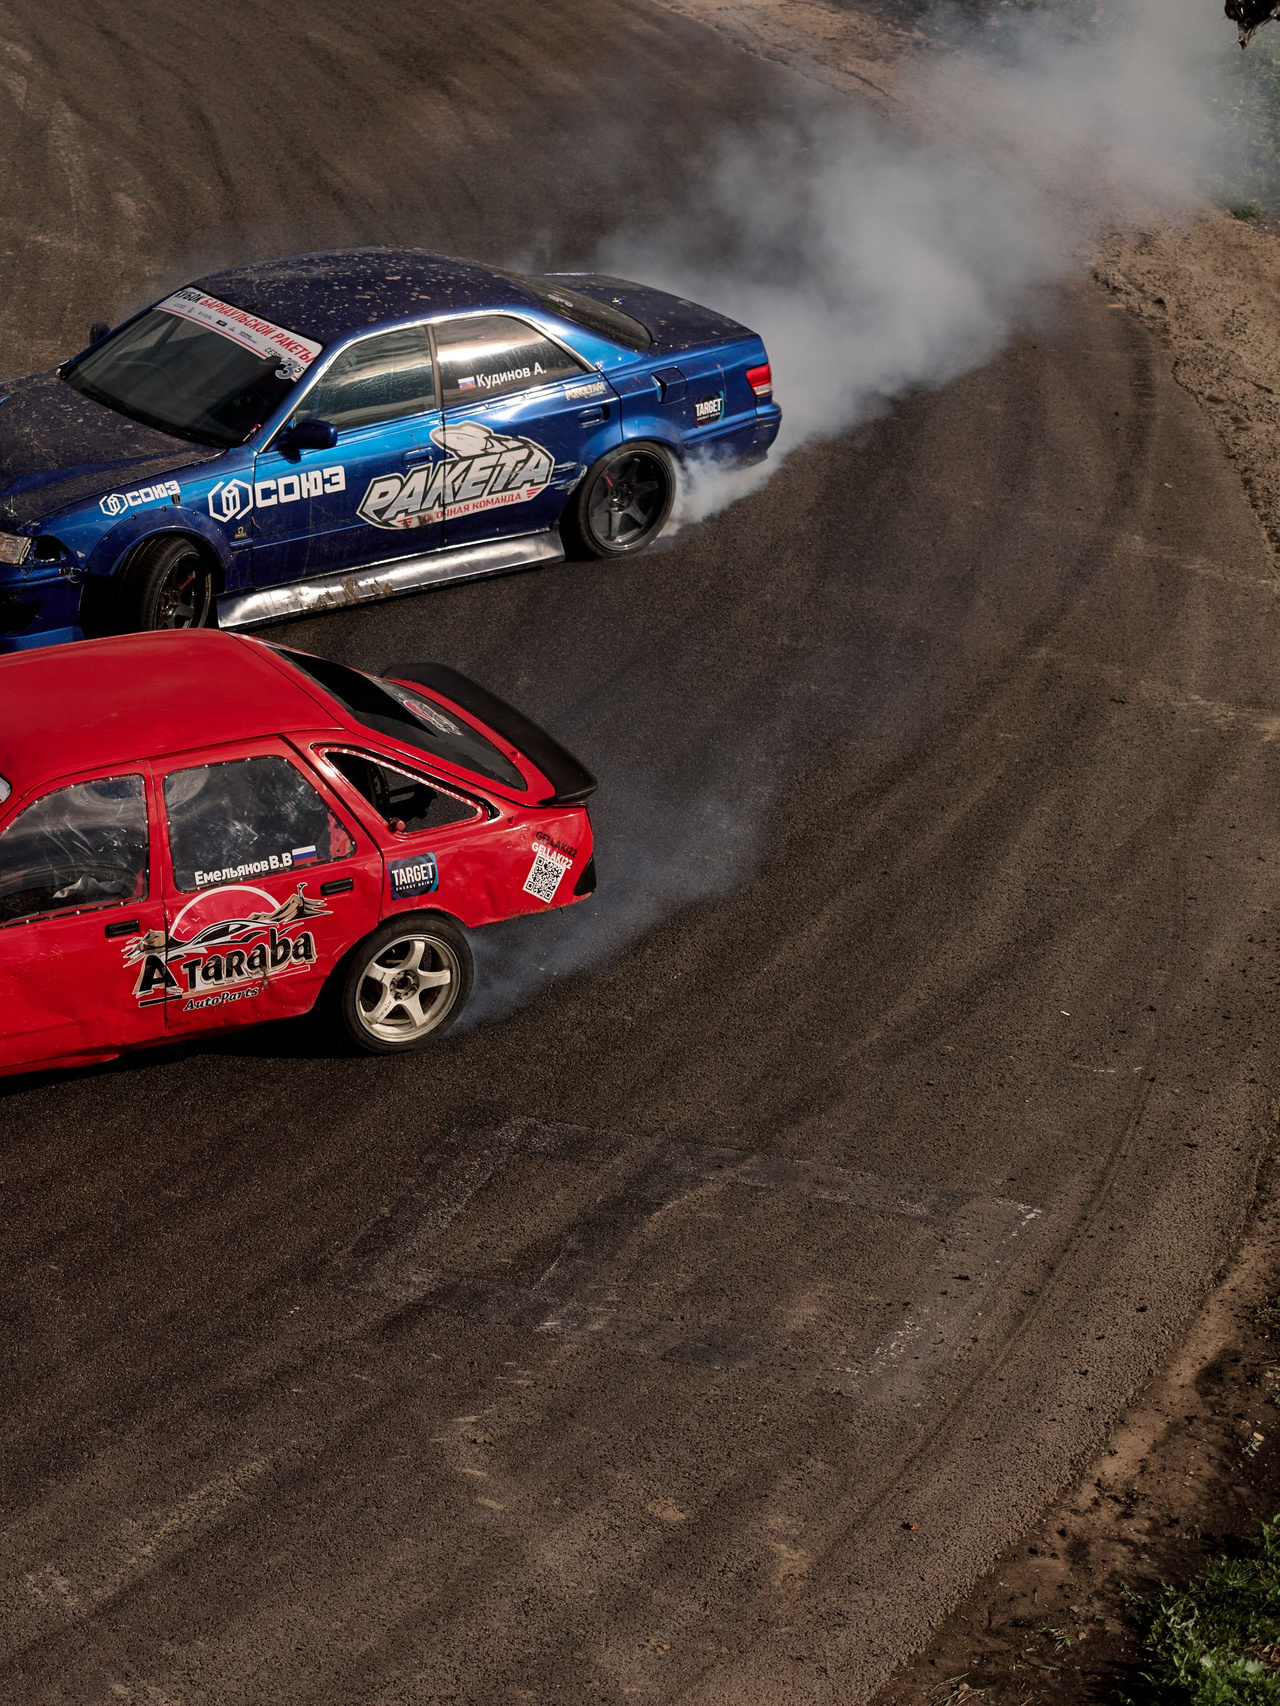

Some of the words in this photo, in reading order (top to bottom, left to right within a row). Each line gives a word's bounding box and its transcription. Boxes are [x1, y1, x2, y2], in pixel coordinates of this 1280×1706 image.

[199, 298, 275, 337] БАРНАУЛЬСКОЙ
[270, 332, 317, 364] РАКЕТЫ
[274, 359, 298, 379] 3
[476, 366, 531, 389] Кудинов
[533, 362, 547, 376] А.
[695, 398, 722, 417] TARGET
[126, 480, 181, 507] СОЮЗ
[254, 465, 346, 508] СОЮЗ
[362, 446, 551, 522] РАКЕТА
[472, 492, 522, 510] КОМАНДА
[531, 842, 573, 870] GELLAKI22
[535, 831, 578, 859] GELLAKI22
[194, 860, 269, 885] Емельянов
[391, 862, 434, 886] TARGET
[183, 987, 259, 1012] AutoParts
